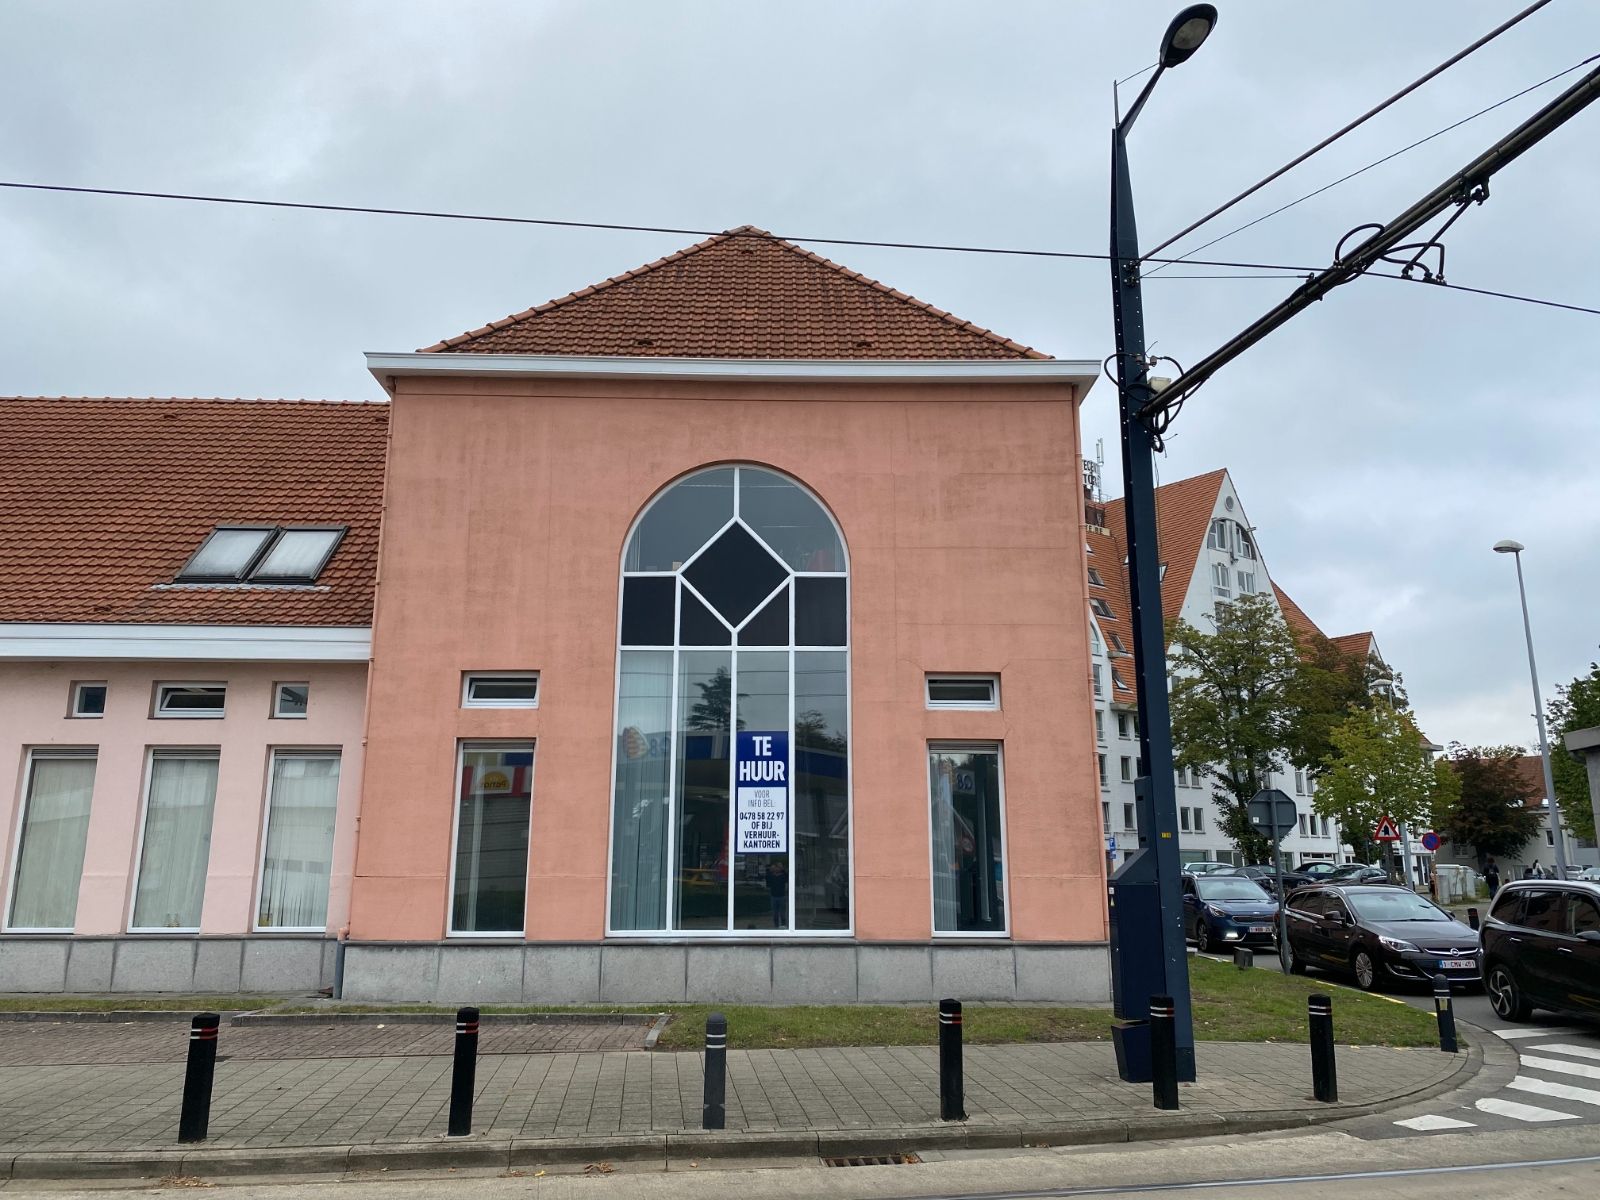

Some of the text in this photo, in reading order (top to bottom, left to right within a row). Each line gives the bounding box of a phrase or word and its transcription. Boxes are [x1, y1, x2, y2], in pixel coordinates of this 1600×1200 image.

[752, 736, 772, 756] TE
[739, 761, 785, 781] HUUR
[754, 790, 769, 798] VOOR
[748, 799, 761, 807] INFO
[739, 812, 784, 820] 0478 58 22 97
[751, 821, 773, 829] OF BIJ
[744, 831, 780, 839] VERHUUR-
[744, 840, 780, 848] KANTOREN
